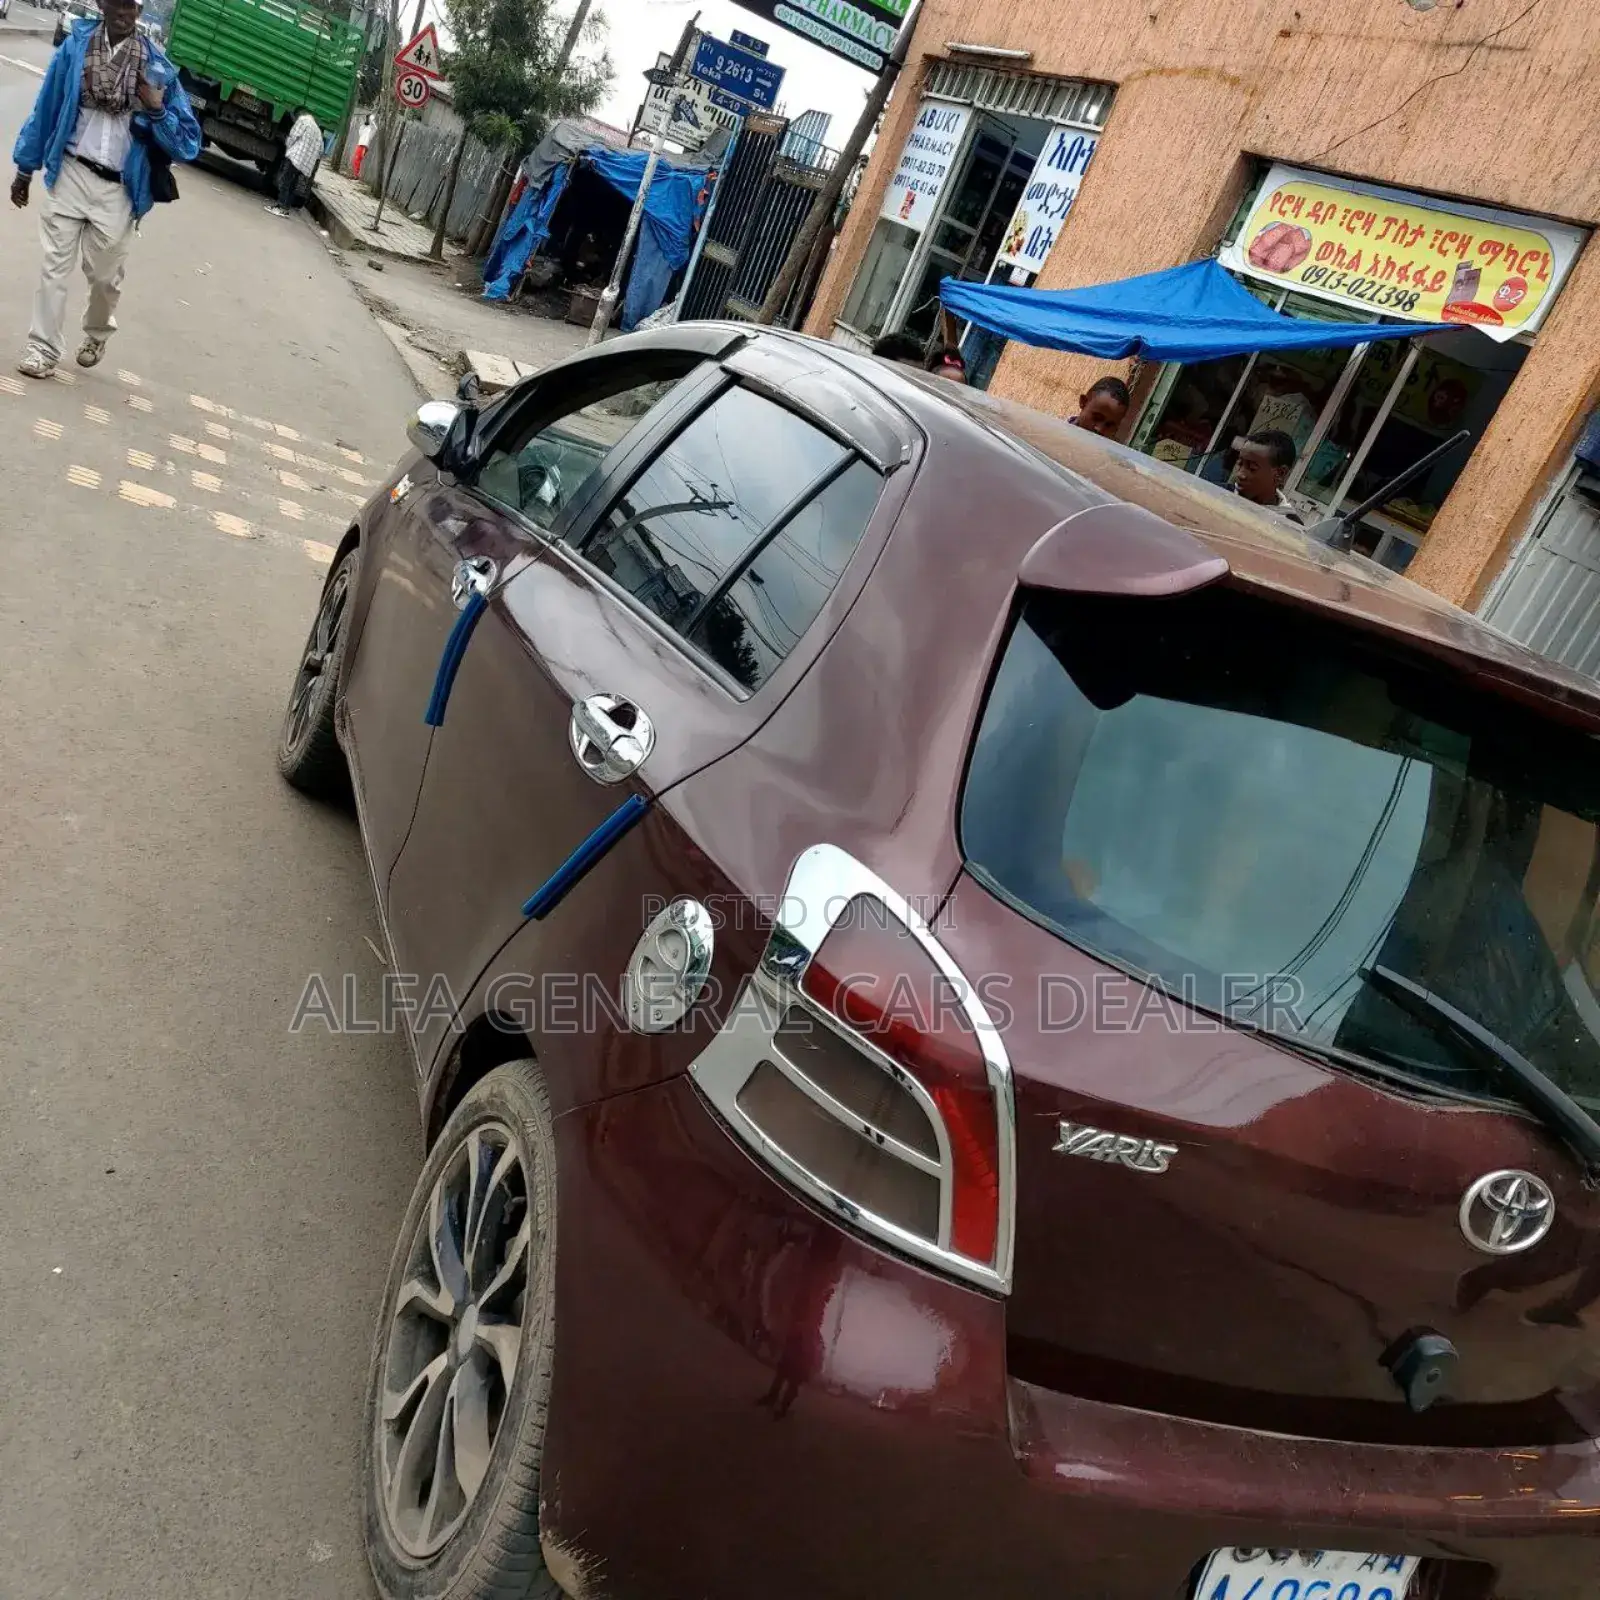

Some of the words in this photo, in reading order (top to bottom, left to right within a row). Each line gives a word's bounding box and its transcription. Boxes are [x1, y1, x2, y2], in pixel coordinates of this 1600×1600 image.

[810, 0, 898, 51] HARMACY
[696, 61, 722, 80] Yeka
[403, 78, 423, 99] 30
[917, 107, 960, 134] ABUKI
[908, 134, 955, 157] PHARMACY
[1300, 264, 1421, 312] 0913-021398
[1052, 1120, 1179, 1173] YARIS
